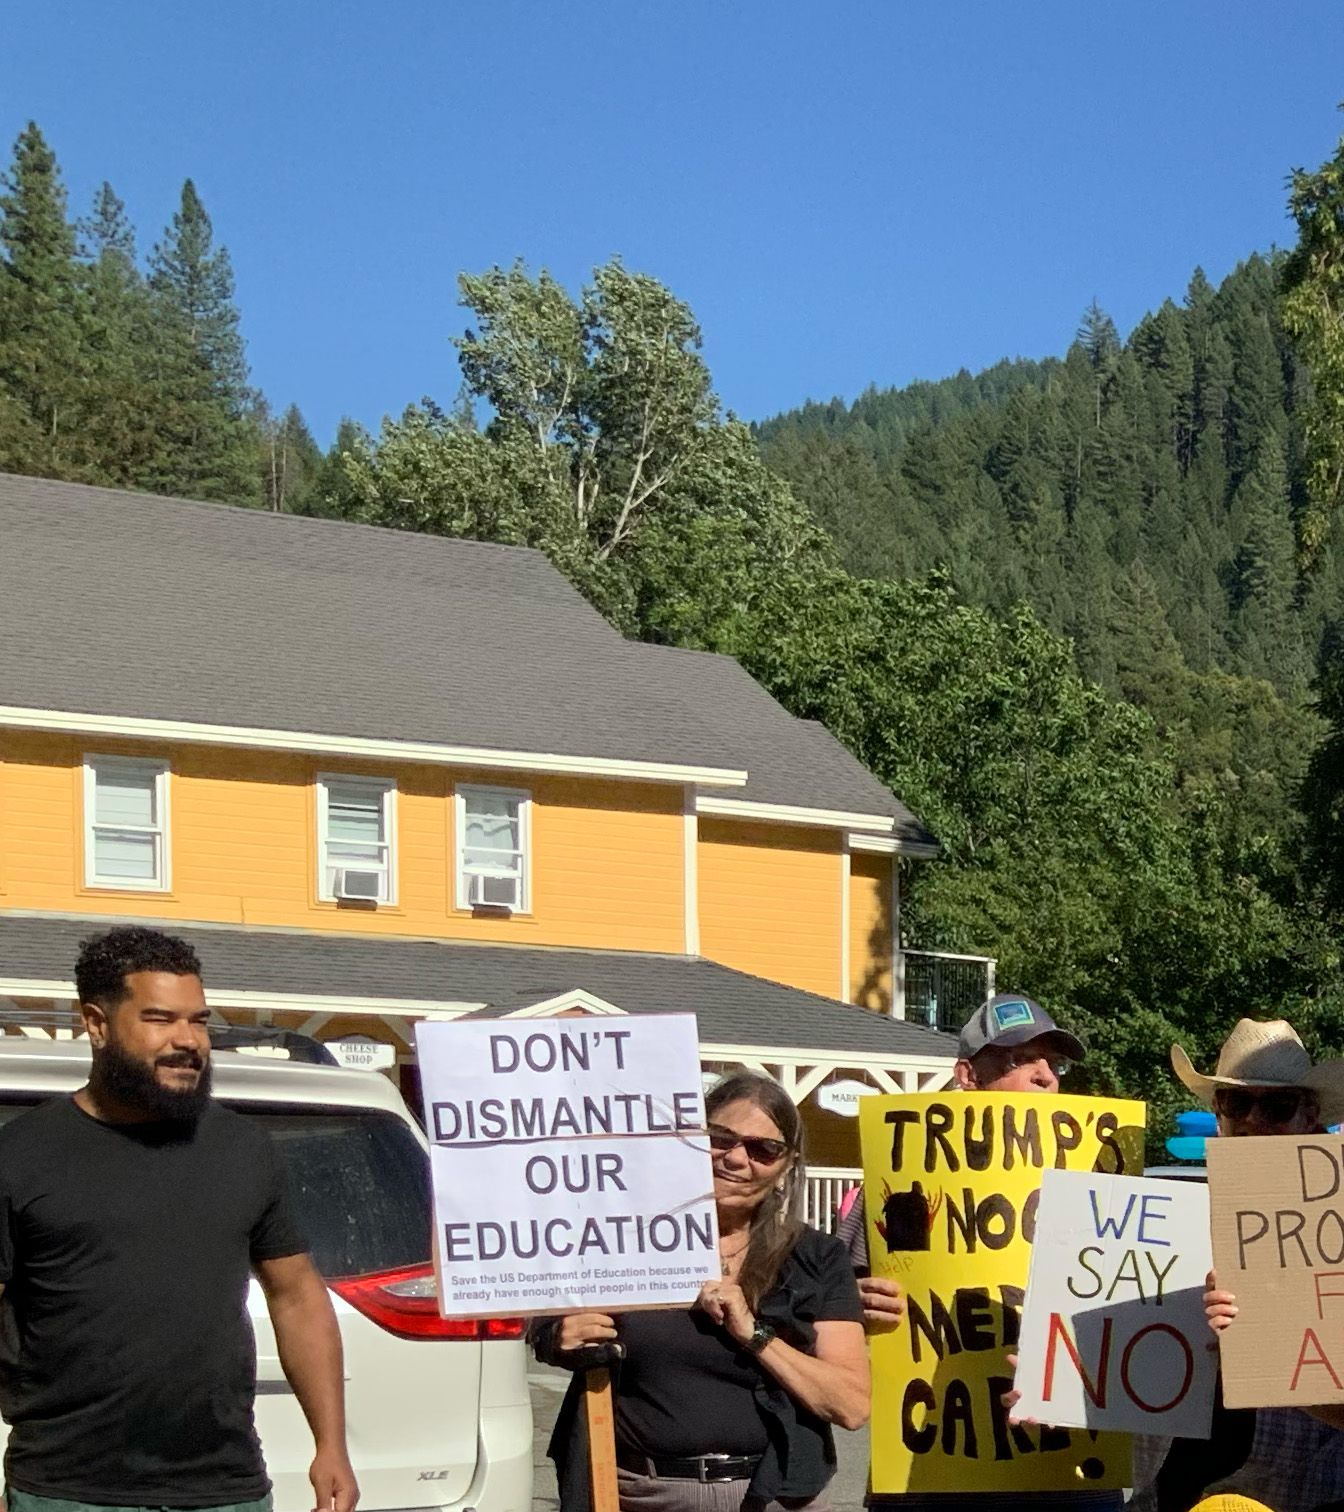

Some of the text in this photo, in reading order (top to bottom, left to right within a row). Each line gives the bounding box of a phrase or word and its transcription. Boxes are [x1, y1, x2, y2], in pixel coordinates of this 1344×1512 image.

[340, 1043, 379, 1054] CHEESE
[345, 1055, 373, 1065] SHOP
[489, 1031, 631, 1074] DON'T
[432, 1092, 700, 1141] DISMANTLE
[884, 1102, 1126, 1176] TRUMP'S
[525, 1153, 627, 1195] OUR
[445, 1212, 714, 1262] EDUCATION
[1089, 1188, 1173, 1248] WE
[451, 1265, 709, 1286] Save the US Department of Education because we
[453, 1289, 491, 1302] already
[495, 1287, 520, 1299] have
[522, 1286, 562, 1299] enough
[564, 1284, 597, 1298] stupid
[599, 1282, 635, 1295] people
[637, 1281, 646, 1291] in
[649, 1280, 669, 1290] this
[1067, 1246, 1179, 1307] SAY
[1041, 1312, 1194, 1415] NO
[417, 1470, 450, 1481] XLE
